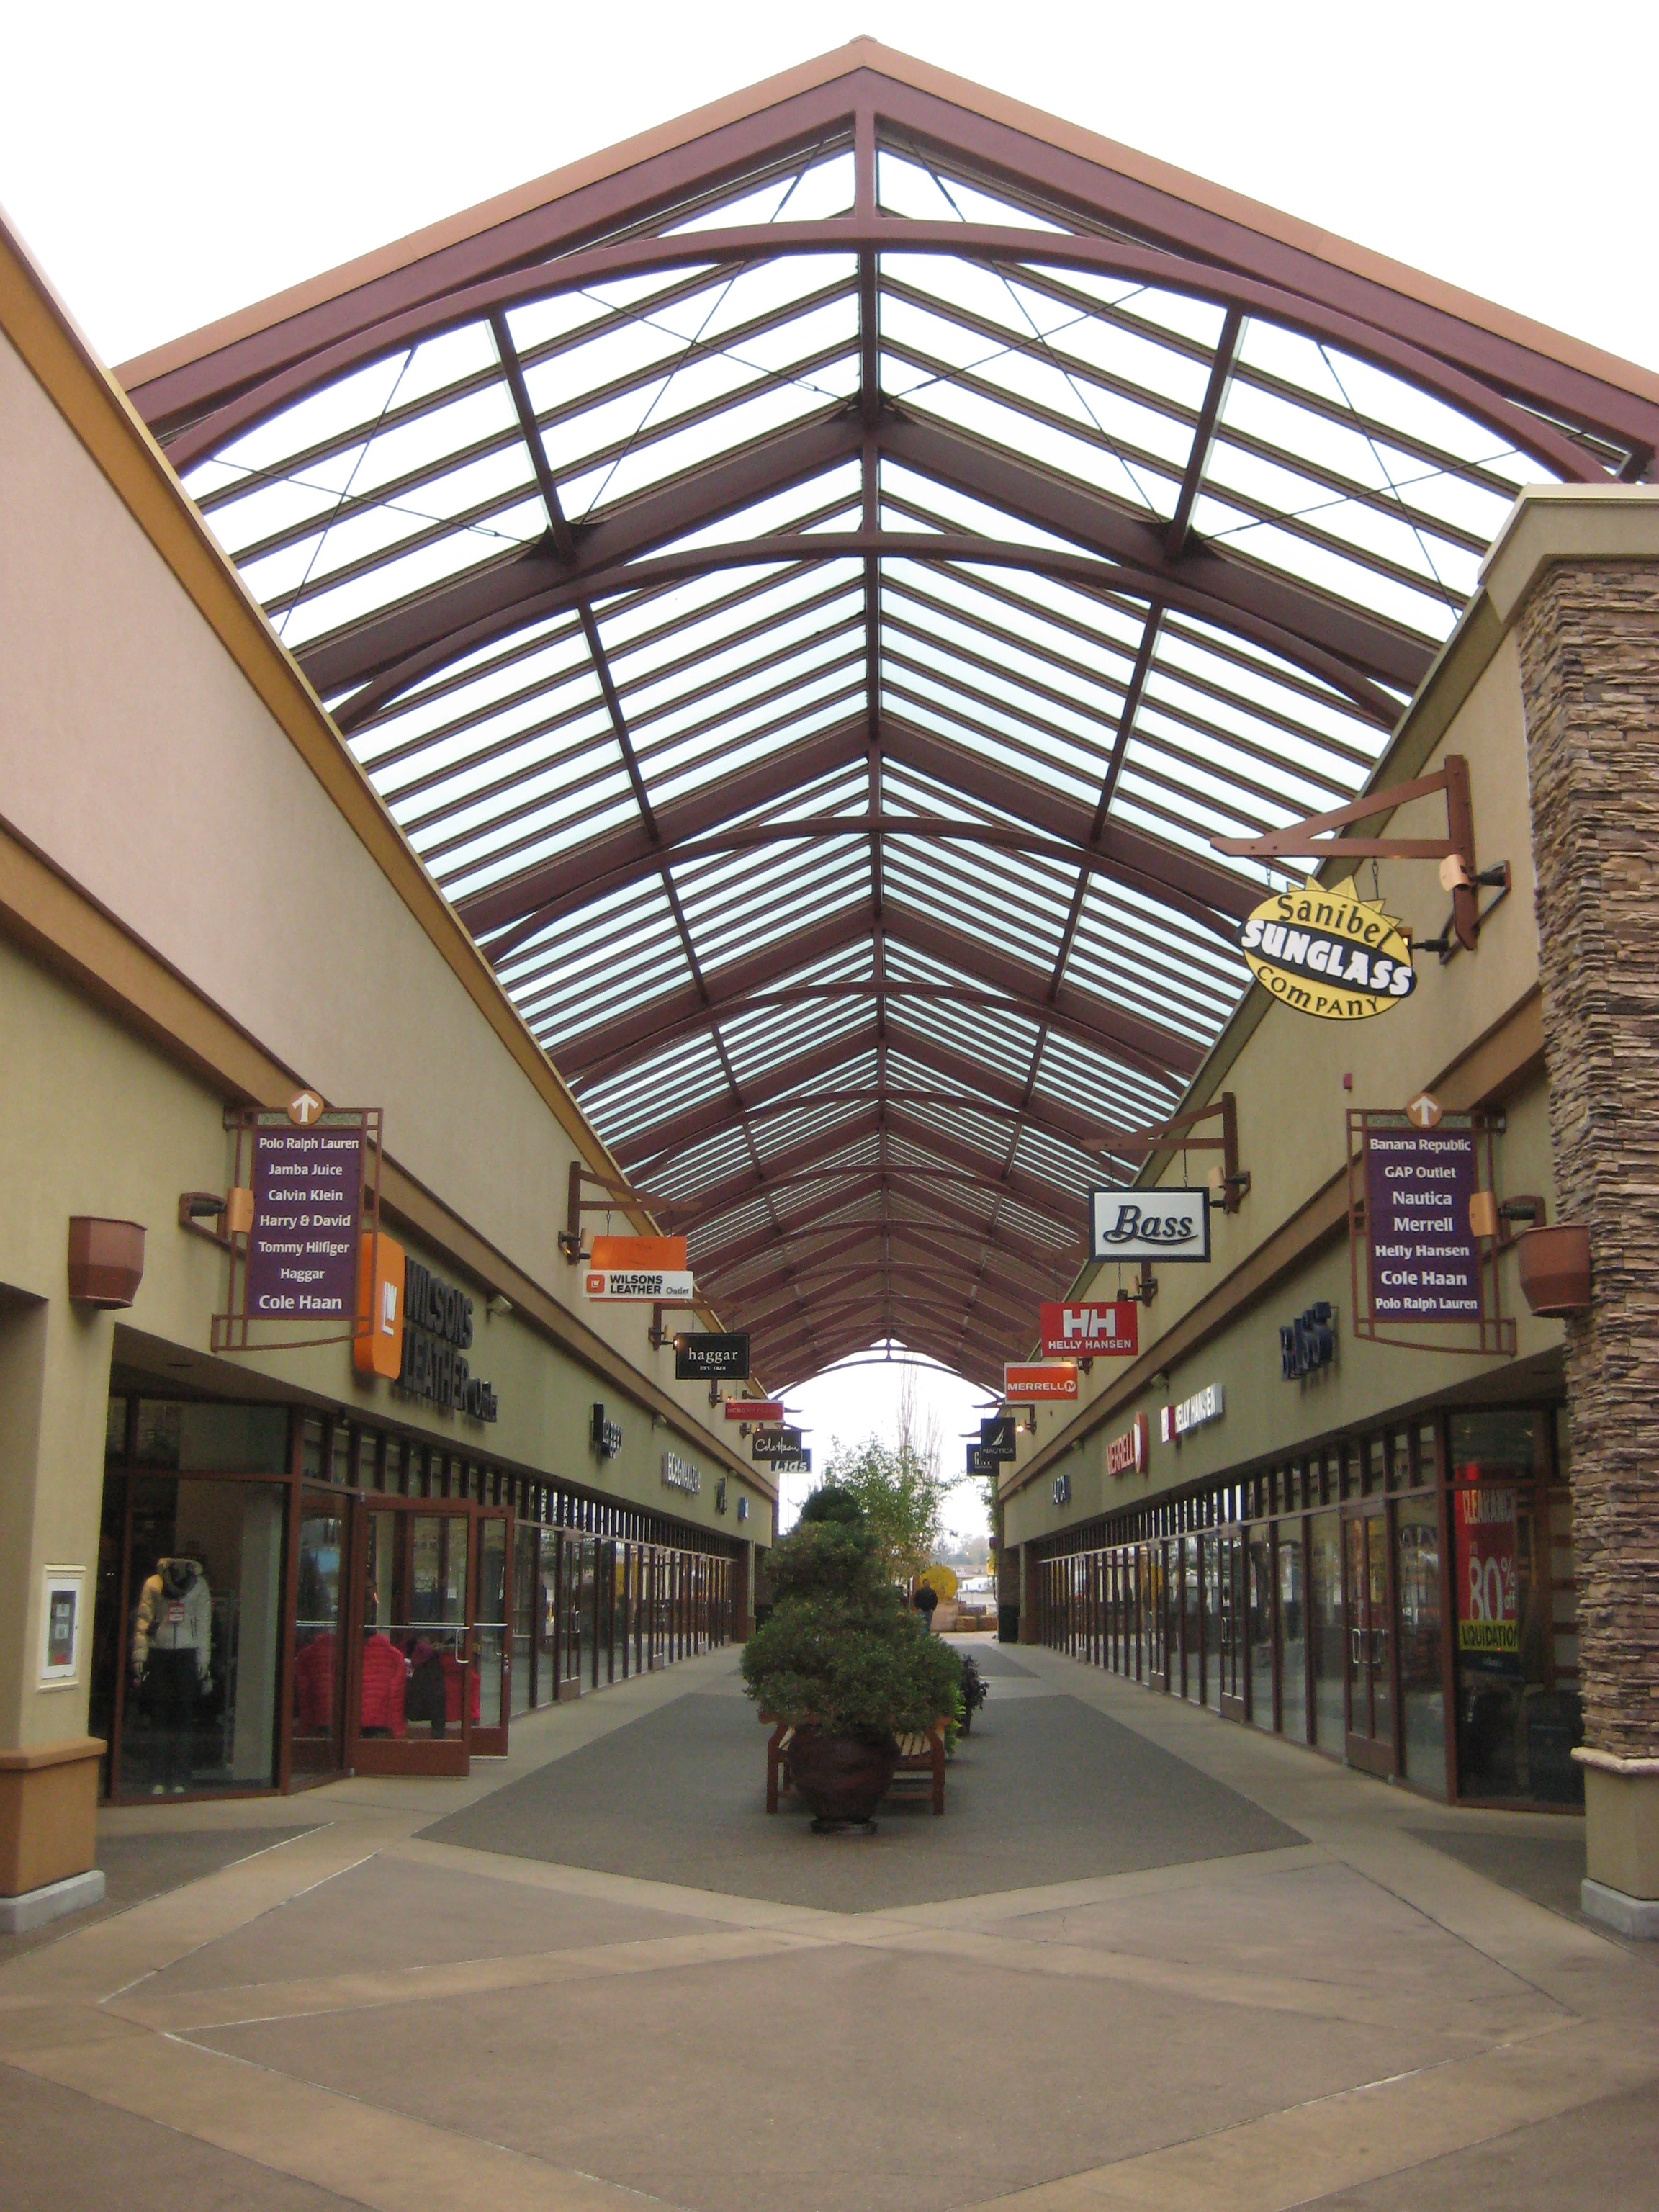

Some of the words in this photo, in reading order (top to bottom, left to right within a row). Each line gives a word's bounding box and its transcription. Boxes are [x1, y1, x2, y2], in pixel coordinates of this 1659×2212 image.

[1277, 894, 1395, 950] Sanibel
[1241, 920, 1412, 995] SUNGLASS
[1257, 966, 1382, 1016] COMPANY
[259, 1138, 284, 1149] Polo
[287, 1138, 318, 1152] Ralph
[321, 1138, 359, 1150] Lauren
[1370, 1138, 1416, 1151] Banana
[1419, 1138, 1471, 1154] Republic
[269, 1164, 309, 1176] Jamba
[312, 1164, 343, 1176] Juice
[1385, 1166, 1413, 1178] GAP
[1416, 1166, 1456, 1179] Outlet
[269, 1189, 307, 1201] Calvin
[310, 1189, 343, 1201] Klein
[1393, 1191, 1452, 1205] Nautica
[259, 1215, 297, 1229] Harry
[300, 1215, 310, 1226] &
[313, 1215, 351, 1226] David
[1102, 1205, 1199, 1245] Bass
[1393, 1217, 1453, 1232] Merrell
[259, 1241, 303, 1256] Tommy
[306, 1240, 349, 1256] Hilfiger
[1375, 1245, 1413, 1259] Helly
[1416, 1245, 1470, 1256] Hansen
[280, 1268, 325, 1282] Haggar
[611, 1275, 663, 1284] WILSONS
[1381, 1271, 1418, 1285] Cole
[1421, 1271, 1467, 1286] Haan
[611, 1285, 662, 1294] LEATHER
[259, 1294, 295, 1310] Cole
[299, 1295, 342, 1310] Haan
[1375, 1298, 1401, 1309] Polo
[1403, 1298, 1437, 1312] Ralph
[1439, 1298, 1478, 1310] Lauren
[1048, 1341, 1083, 1350] HELLY
[1085, 1340, 1132, 1349] HANSEN
[688, 1346, 738, 1364] haggar
[1007, 1382, 1064, 1391] MERRELL
[774, 1460, 808, 1473] Lids
